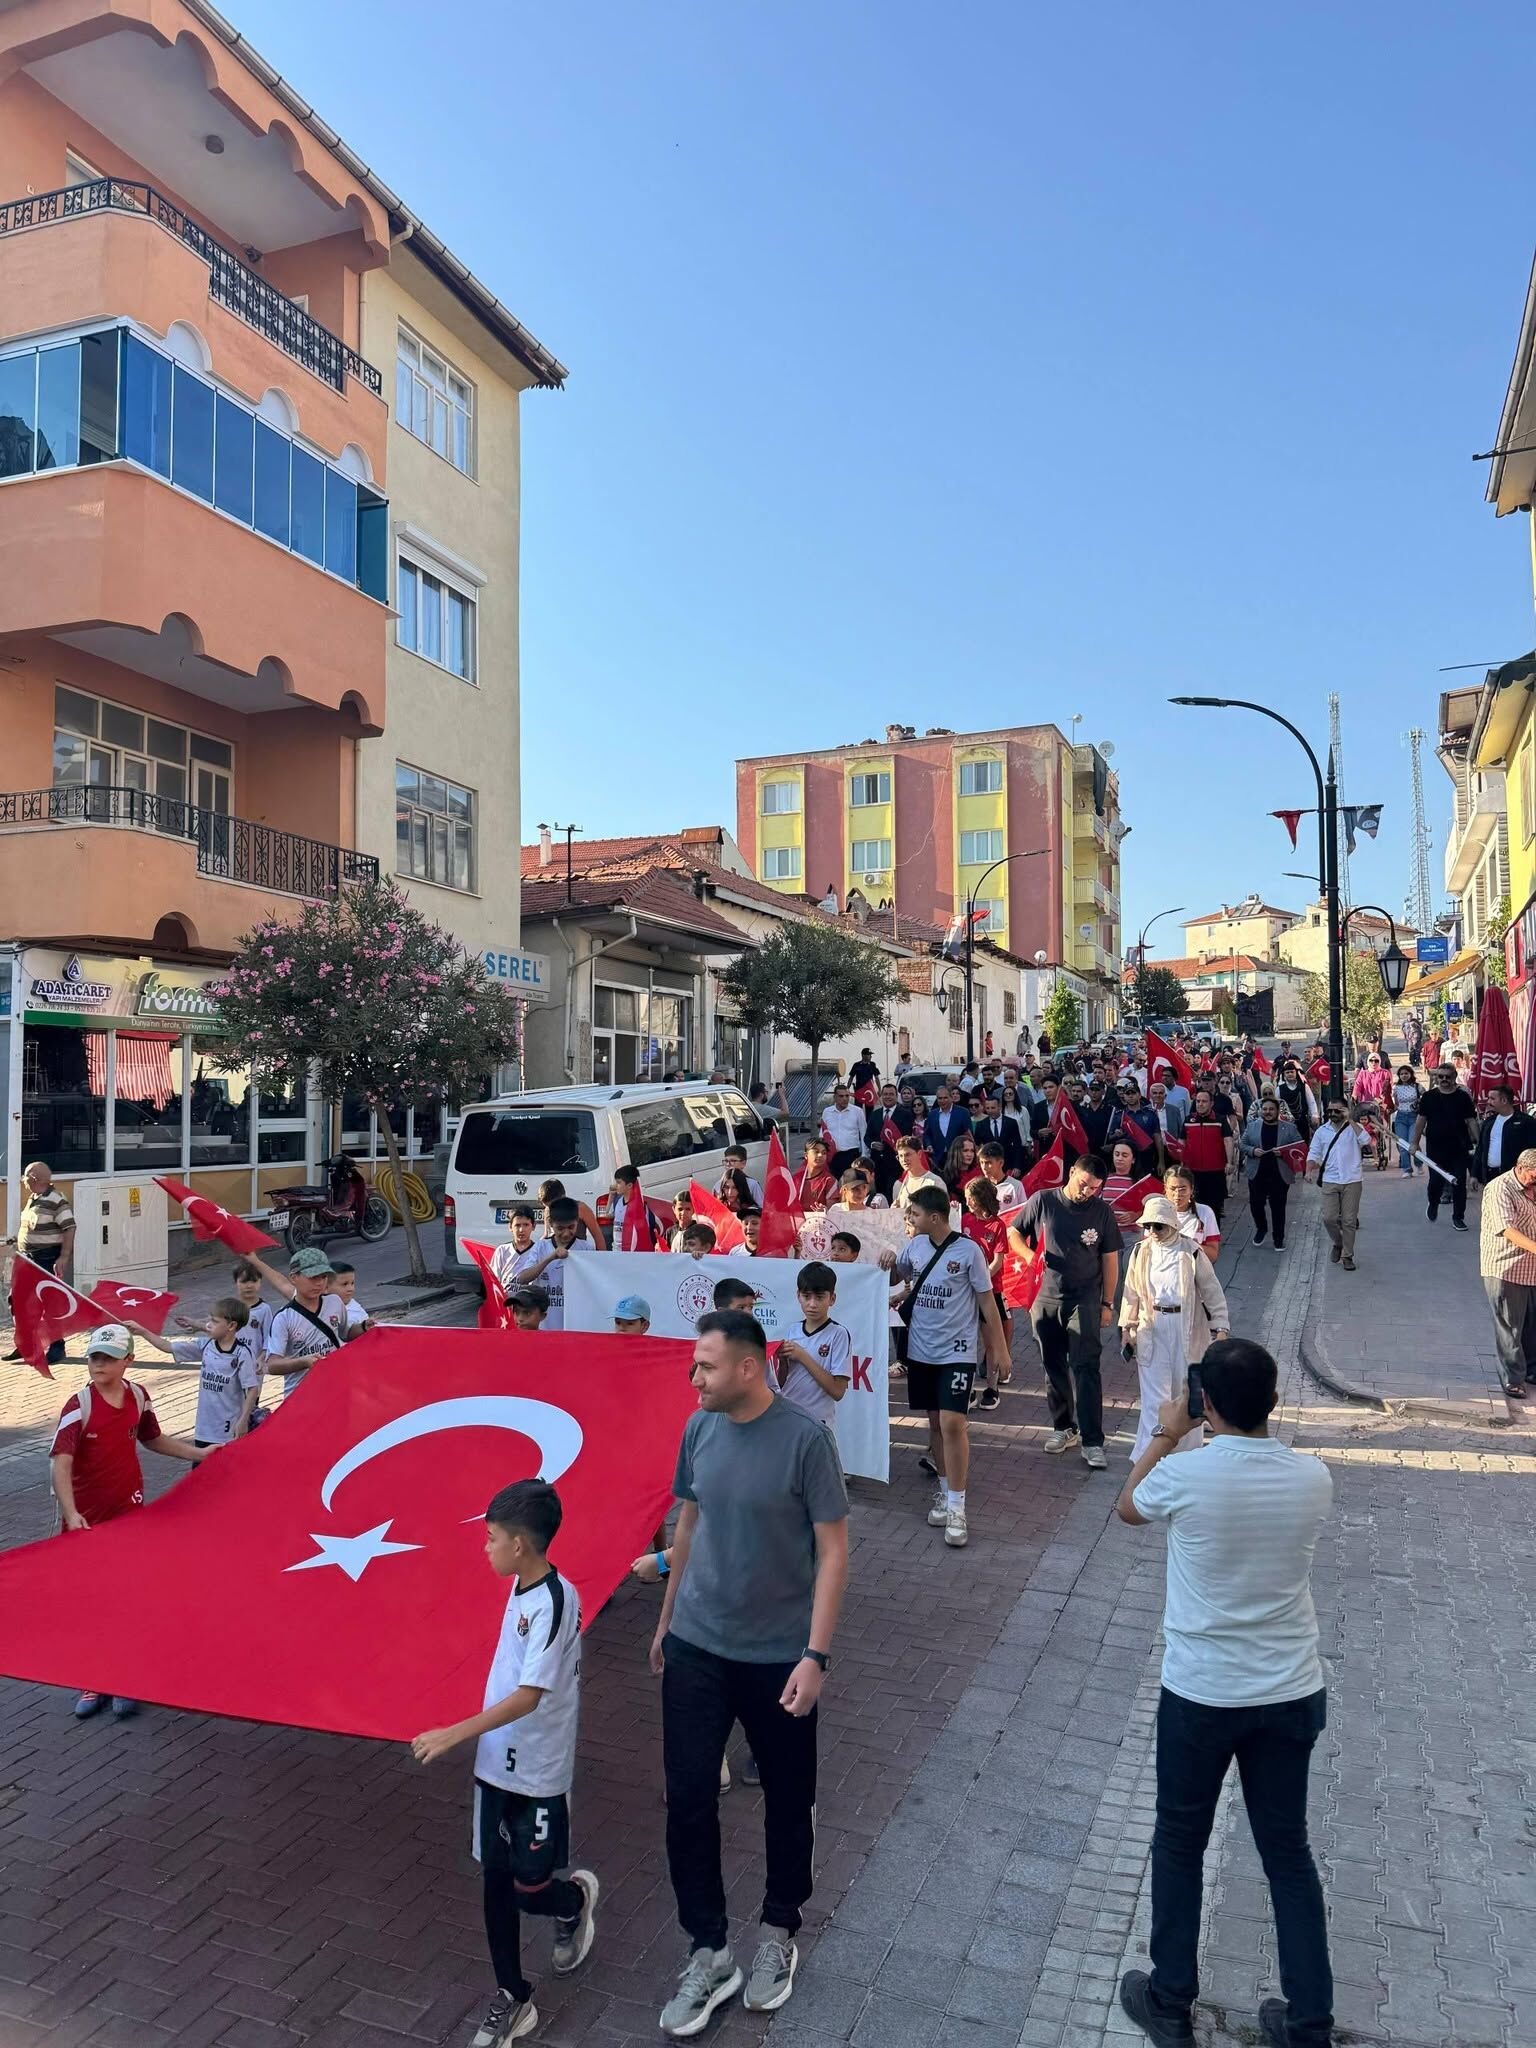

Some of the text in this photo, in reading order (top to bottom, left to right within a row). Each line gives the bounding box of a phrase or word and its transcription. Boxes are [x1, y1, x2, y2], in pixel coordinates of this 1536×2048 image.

[485, 951, 541, 984] SEREL
[37, 981, 63, 995] ADA
[920, 1284, 953, 1298] BÜLOĞLU
[953, 1339, 968, 1353] 25
[852, 1355, 873, 1393] K
[951, 1371, 968, 1391] 25
[224, 1420, 231, 1433] 3
[131, 1489, 143, 1505] 15
[506, 1747, 517, 1773] 5
[535, 1807, 549, 1841] 5
